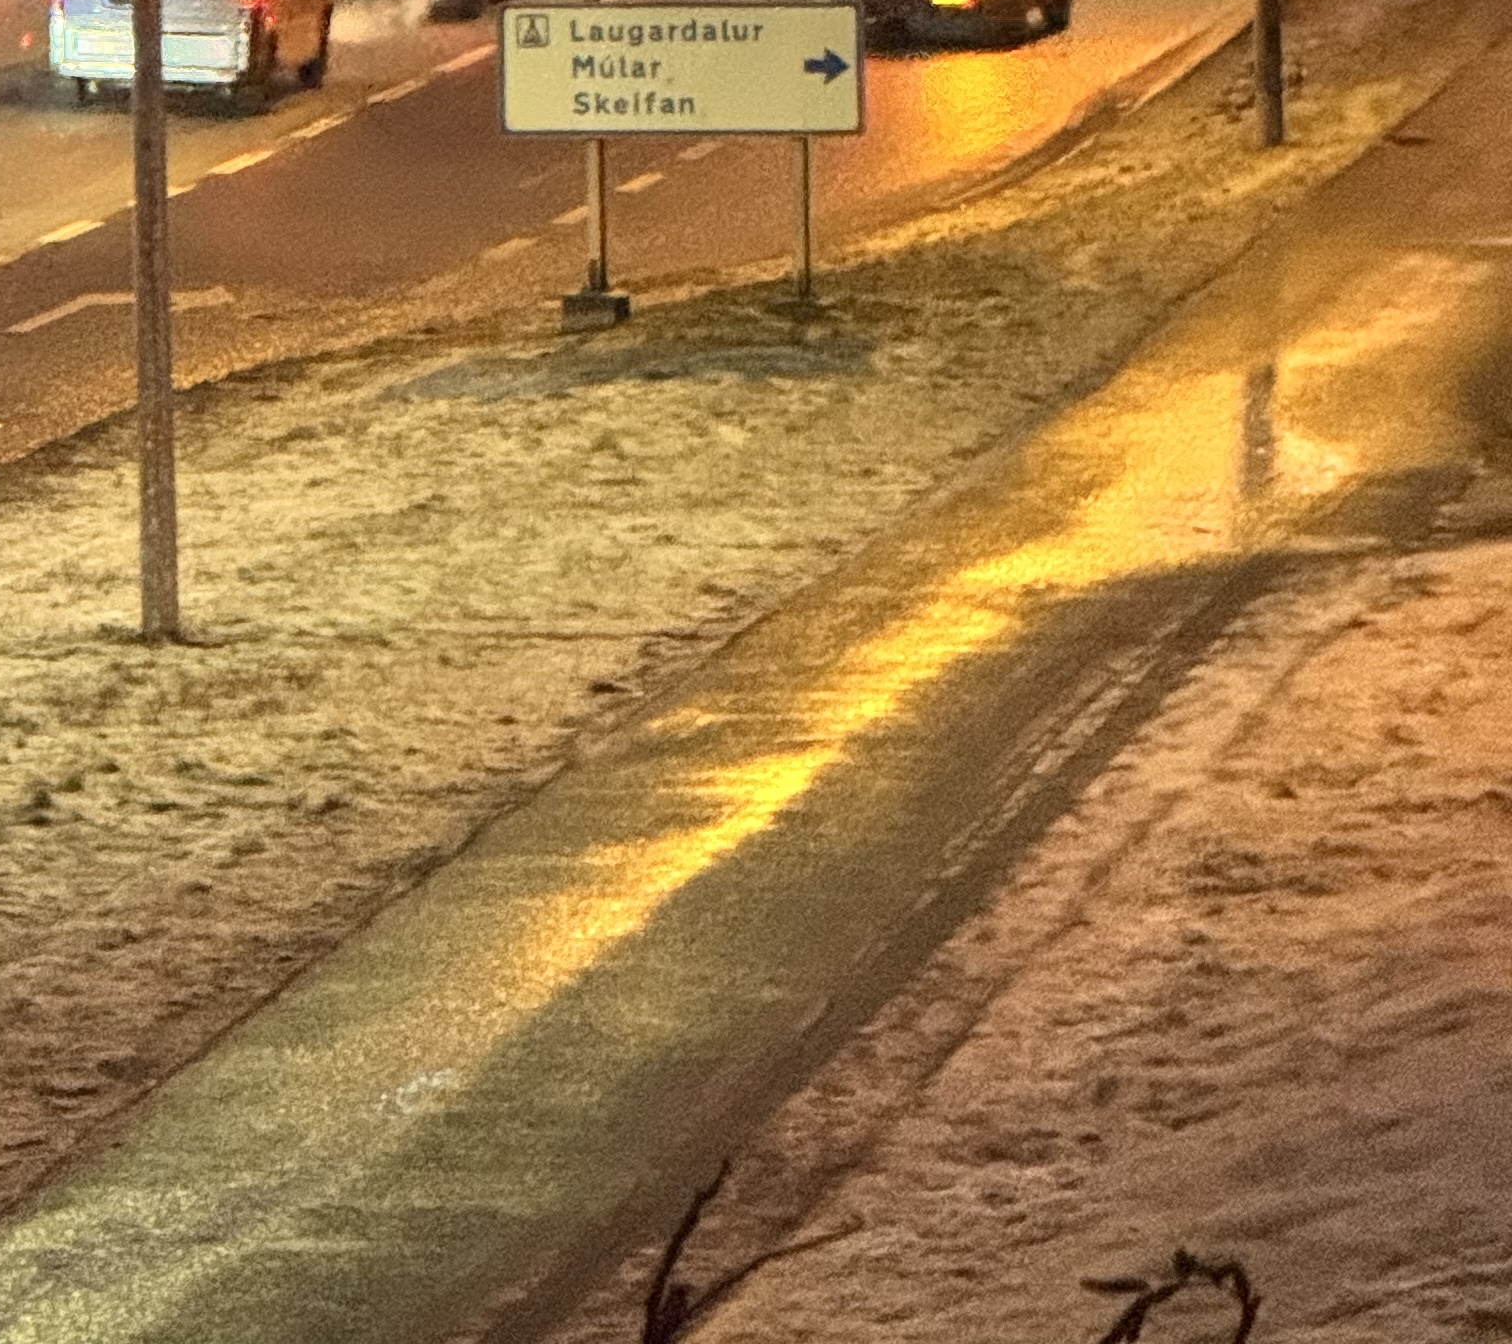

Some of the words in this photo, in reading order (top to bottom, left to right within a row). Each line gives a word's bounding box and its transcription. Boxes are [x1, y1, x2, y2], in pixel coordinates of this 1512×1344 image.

[569, 18, 764, 46] Laugardalur
[571, 54, 663, 79] Múlar
[573, 91, 696, 115] Skeifan
